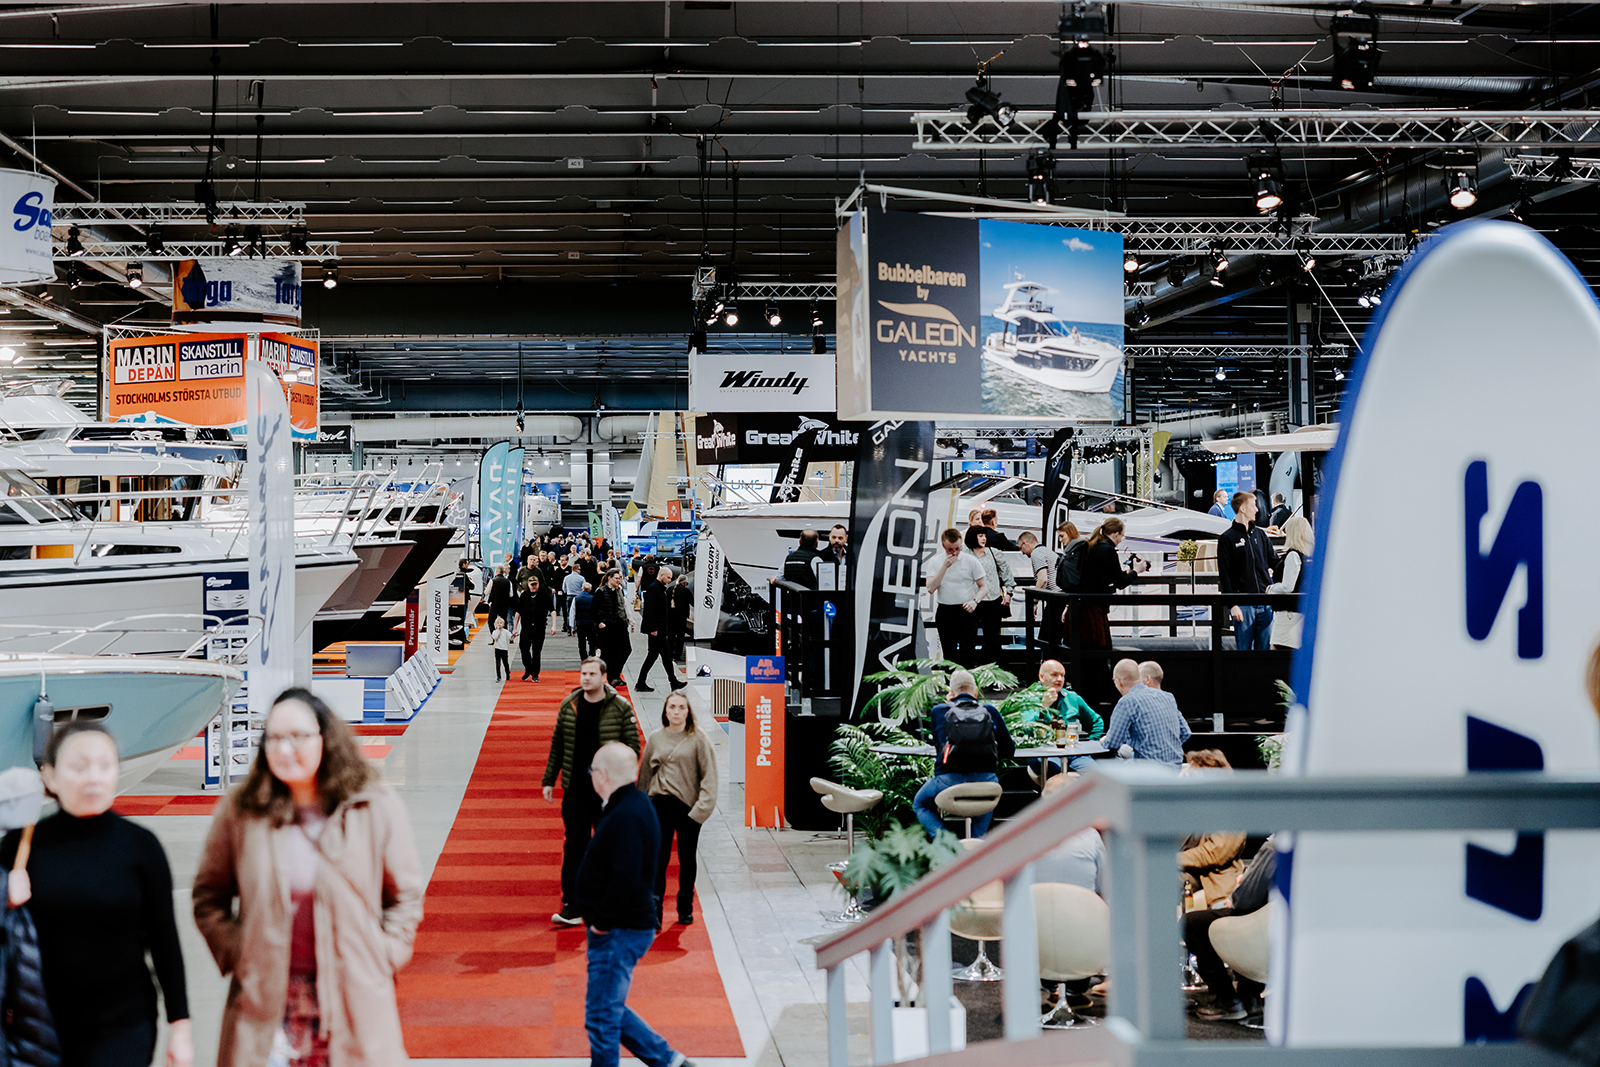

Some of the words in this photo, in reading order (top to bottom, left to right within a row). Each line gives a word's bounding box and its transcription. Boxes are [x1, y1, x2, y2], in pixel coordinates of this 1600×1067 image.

[877, 262, 967, 288] Bubbelbaren
[916, 285, 930, 301] by
[876, 319, 977, 349] GALEON
[116, 345, 174, 367] MARIN
[181, 342, 241, 360] SKANSTULL
[261, 339, 288, 363] MARIN
[289, 347, 315, 366] SKANSTULL
[898, 349, 958, 365] YACHTS
[128, 363, 174, 381] DEPÅN
[194, 360, 240, 376] marin
[719, 371, 809, 395] Windy
[116, 392, 171, 405] STOCKHOLMS
[173, 388, 211, 402] STÖRSTA
[212, 387, 242, 399] UTBUD
[706, 542, 715, 594] MERCURY
[408, 608, 416, 646] Premiär
[434, 590, 442, 653] ASKELADDEN
[756, 695, 772, 766] Premiär
